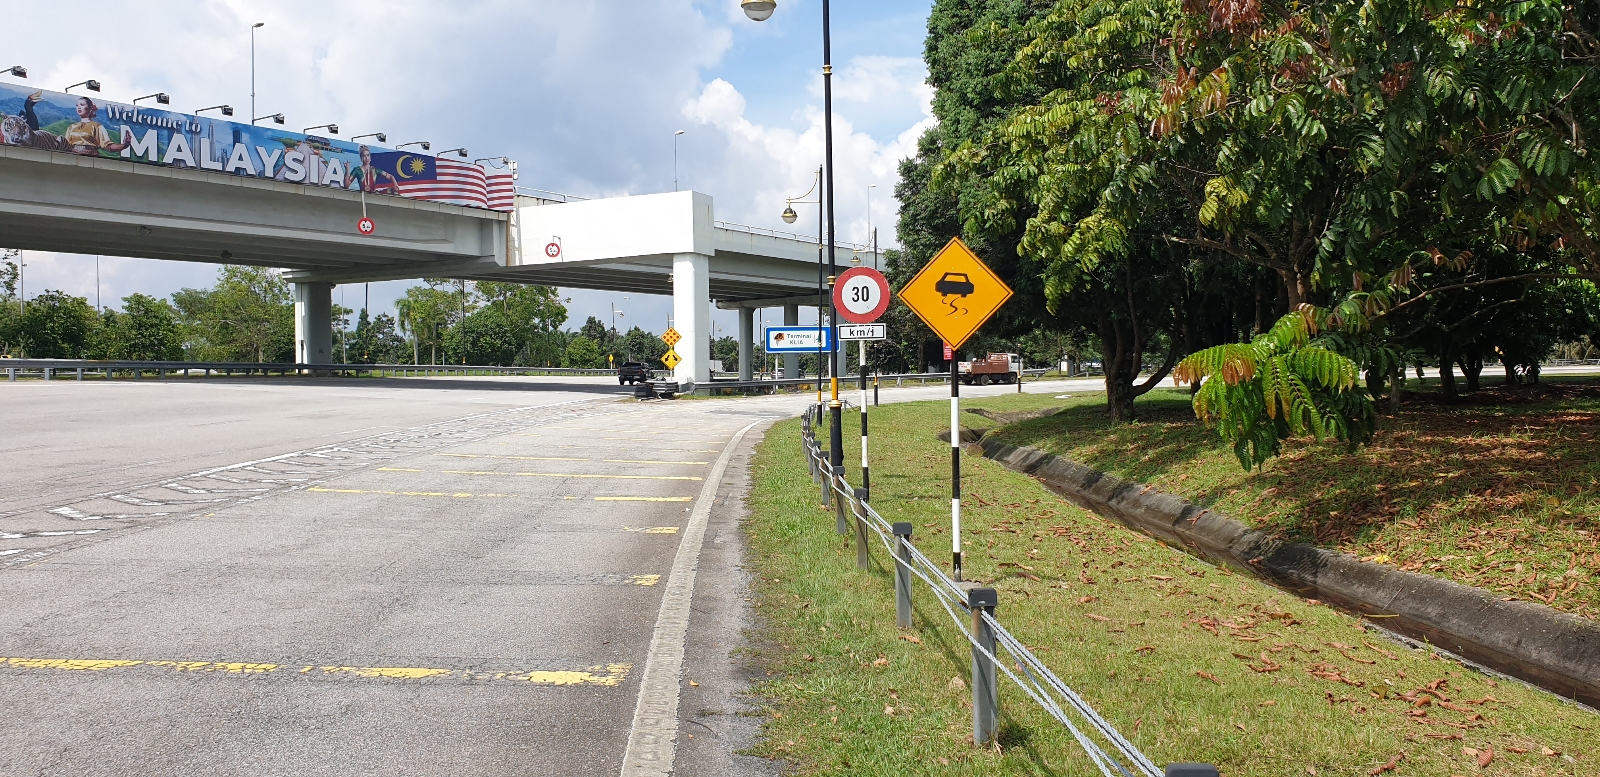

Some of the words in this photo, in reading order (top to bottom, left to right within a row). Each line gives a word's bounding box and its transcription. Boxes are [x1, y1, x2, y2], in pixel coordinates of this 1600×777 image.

[106, 103, 182, 130] Welcome
[184, 116, 202, 133] to
[120, 125, 345, 187] MALAYSIA
[852, 286, 869, 303] 30
[849, 327, 874, 337] km/j
